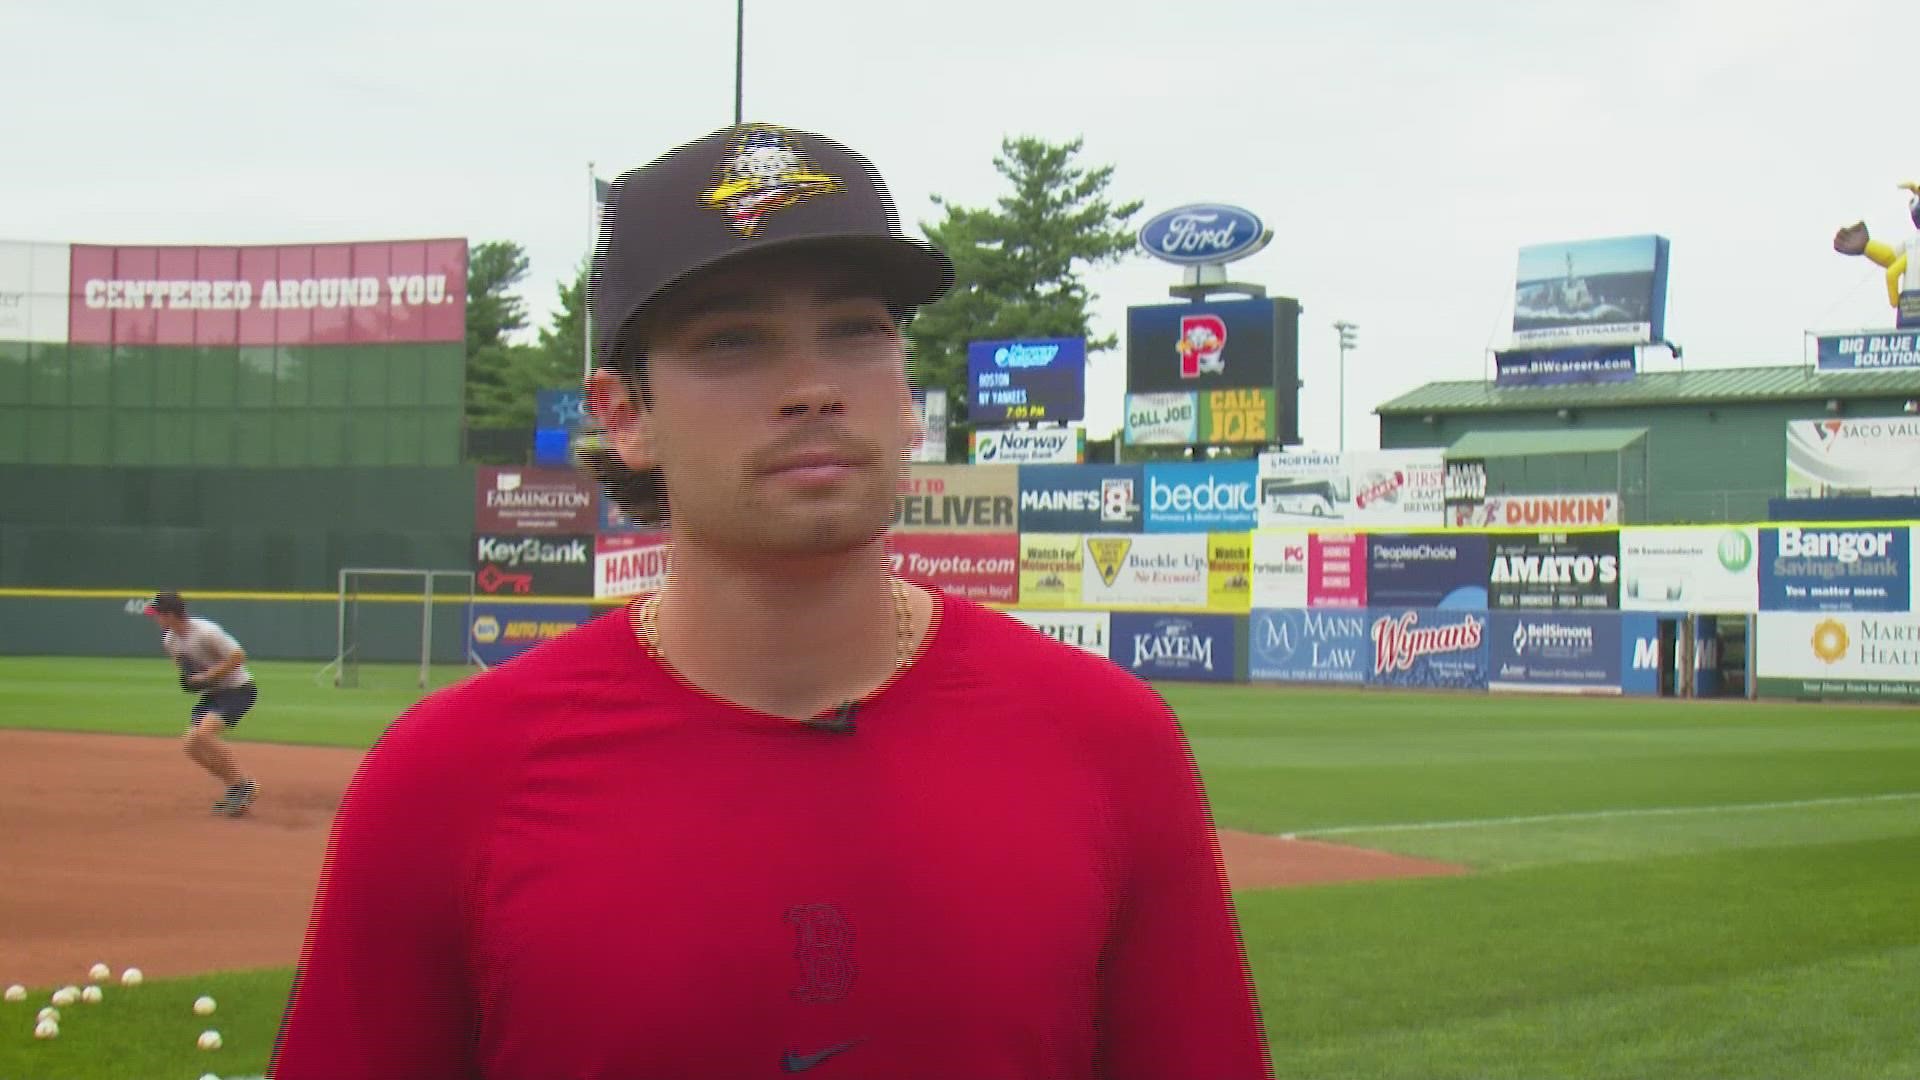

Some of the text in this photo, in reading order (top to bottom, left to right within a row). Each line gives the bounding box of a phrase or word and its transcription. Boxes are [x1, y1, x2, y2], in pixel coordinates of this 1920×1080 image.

[1162, 212, 1236, 252] Ford
[85, 274, 455, 310] CENTERED AROUND YOU.
[1839, 335, 1912, 354] BIG BLUE
[1501, 357, 1632, 376] www.BIWcareers.com
[1210, 390, 1266, 411] CALL
[1130, 410, 1160, 428] CALL
[1210, 411, 1267, 443] JOE
[1843, 423, 1881, 438] SACO
[1000, 432, 1069, 454] Norway
[486, 490, 591, 508] FARMINGTON
[1021, 490, 1100, 511] MAINE'S
[1150, 474, 1259, 512] bedard
[1505, 497, 1612, 525] DUNKIN'
[478, 537, 588, 567] KeyBank
[1777, 527, 1893, 562] Bangor
[908, 554, 1016, 577] Toyota.com
[1129, 552, 1179, 569] Buckle
[1490, 555, 1618, 583] AMATO'S
[1774, 557, 1899, 580] Savings Bank
[1785, 585, 1807, 597] You
[1810, 585, 1851, 597] matter
[1303, 608, 1365, 641] MANN
[1132, 633, 1213, 671] KAYEM
[1312, 641, 1356, 669] LAW
[1370, 611, 1482, 676] Wyman's
